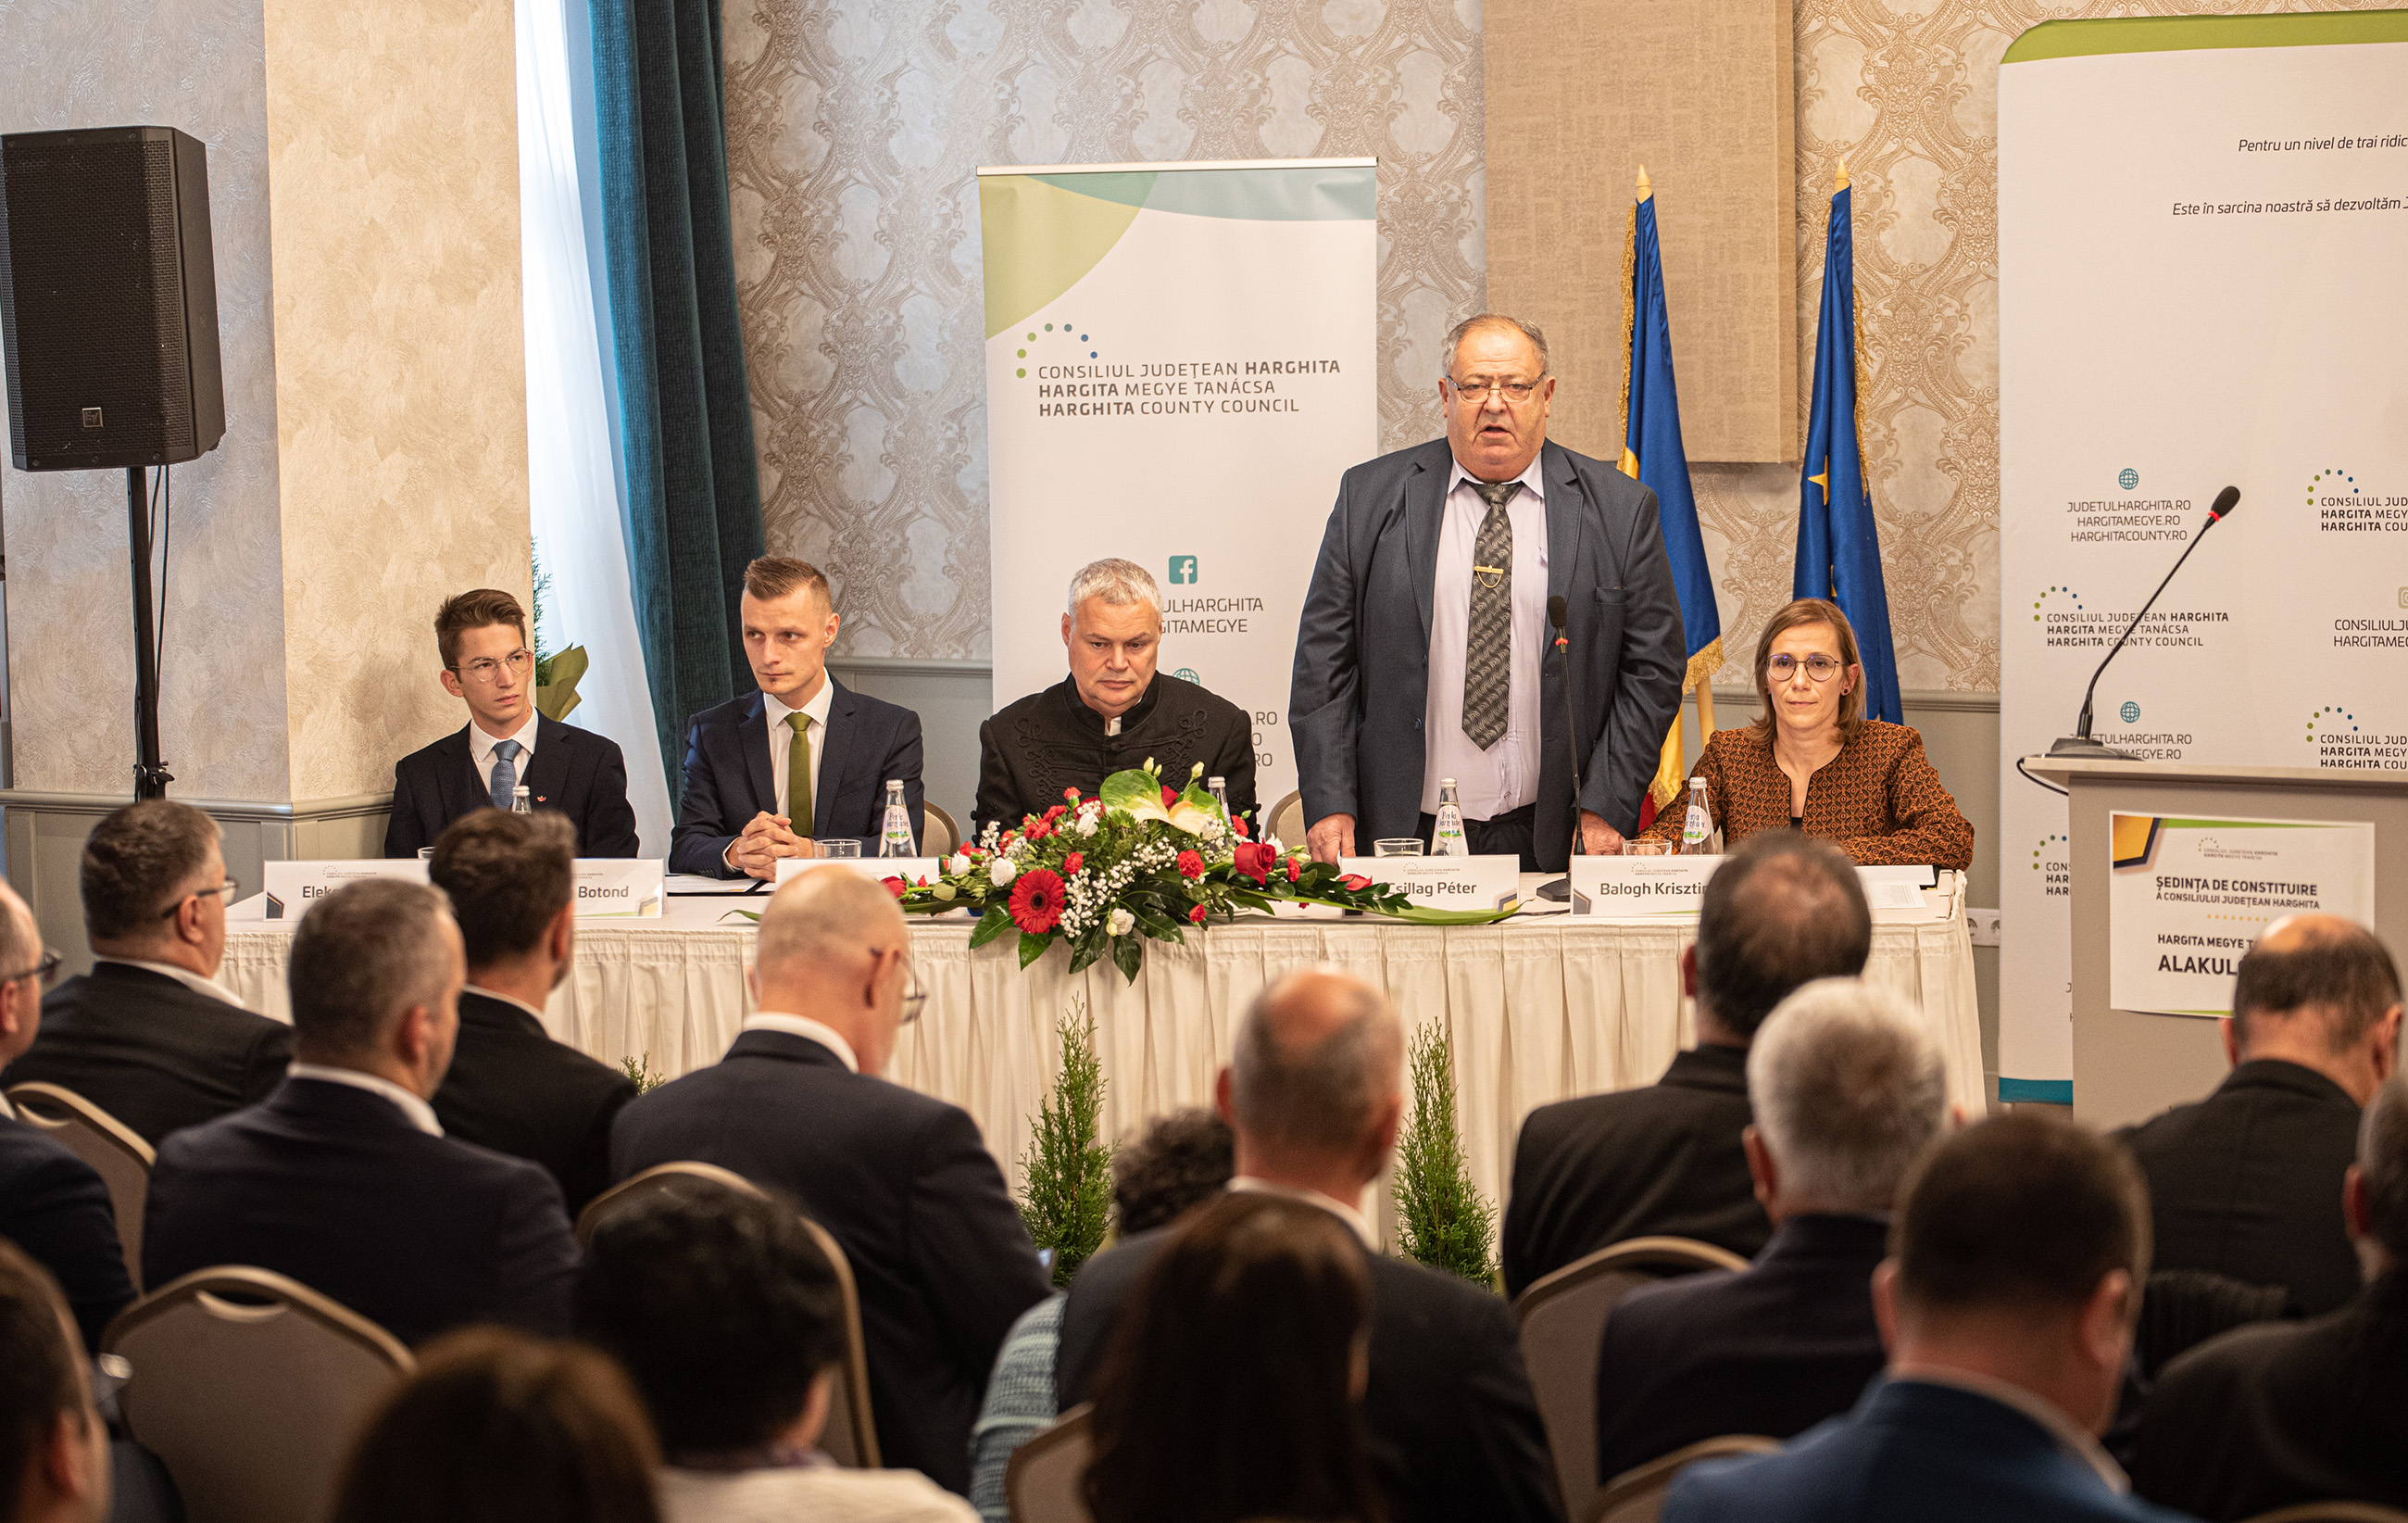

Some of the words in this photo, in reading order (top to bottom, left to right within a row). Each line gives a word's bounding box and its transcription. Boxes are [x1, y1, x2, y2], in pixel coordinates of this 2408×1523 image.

[2239, 139, 2280, 152] Pentru
[2284, 140, 2301, 151] un
[2303, 137, 2335, 150] nivel
[2338, 136, 2353, 149] de
[2356, 135, 2378, 148] trai
[2173, 202, 2200, 215] Este
[2202, 202, 2214, 215] în
[2217, 200, 2262, 214] sarcina
[2265, 199, 2313, 213] noastră
[2315, 199, 2330, 212] să
[2334, 197, 2401, 211] dezvoltăm
[1038, 364, 1135, 379] CONSILIUL
[1246, 360, 1341, 375] HARGHITA
[1039, 383, 1119, 397] HARGITA
[1125, 382, 1187, 396] MEGYE
[1194, 378, 1275, 395] TANÁCSA
[1039, 402, 1135, 417] HARGHITA
[1140, 400, 1214, 415] COUNTY
[1221, 399, 1299, 413] COUNCIL
[2067, 499, 2191, 512] JUDETULHARGHITA.RO
[2321, 497, 2382, 507] CONSILIUL
[2321, 510, 2372, 519] HARGITA
[2077, 515, 2181, 527] HARGITAMEGYE.RO
[2321, 522, 2381, 531] HARGHITA
[2071, 530, 2188, 542] HARGHITACOUNTY.RO
[2047, 613, 2104, 623] CONSILIUL
[2170, 612, 2229, 622] HARGHITA
[2047, 625, 2095, 635] HARGITA
[2139, 623, 2189, 634] TANÁCSA
[2047, 637, 2104, 647] HARGHITA
[2155, 636, 2203, 647] COUNCIL
[2320, 735, 2381, 745] CONSILIUL
[2320, 747, 2371, 756] HARGITA
[2320, 759, 2381, 769] HARGHITA
[578, 886, 629, 898] Botond
[1437, 881, 1477, 894] Péter
[1600, 882, 1651, 898] Balogh
[2213, 879, 2228, 891] DE
[2231, 881, 2317, 896] CONSTITUIRE
[2156, 892, 2163, 900] A
[2163, 892, 2220, 904] CONSILIULUI
[2273, 900, 2320, 910] HARGHITA
[2157, 934, 2203, 946] HARGITA
[2207, 937, 2244, 949] MEGYE
